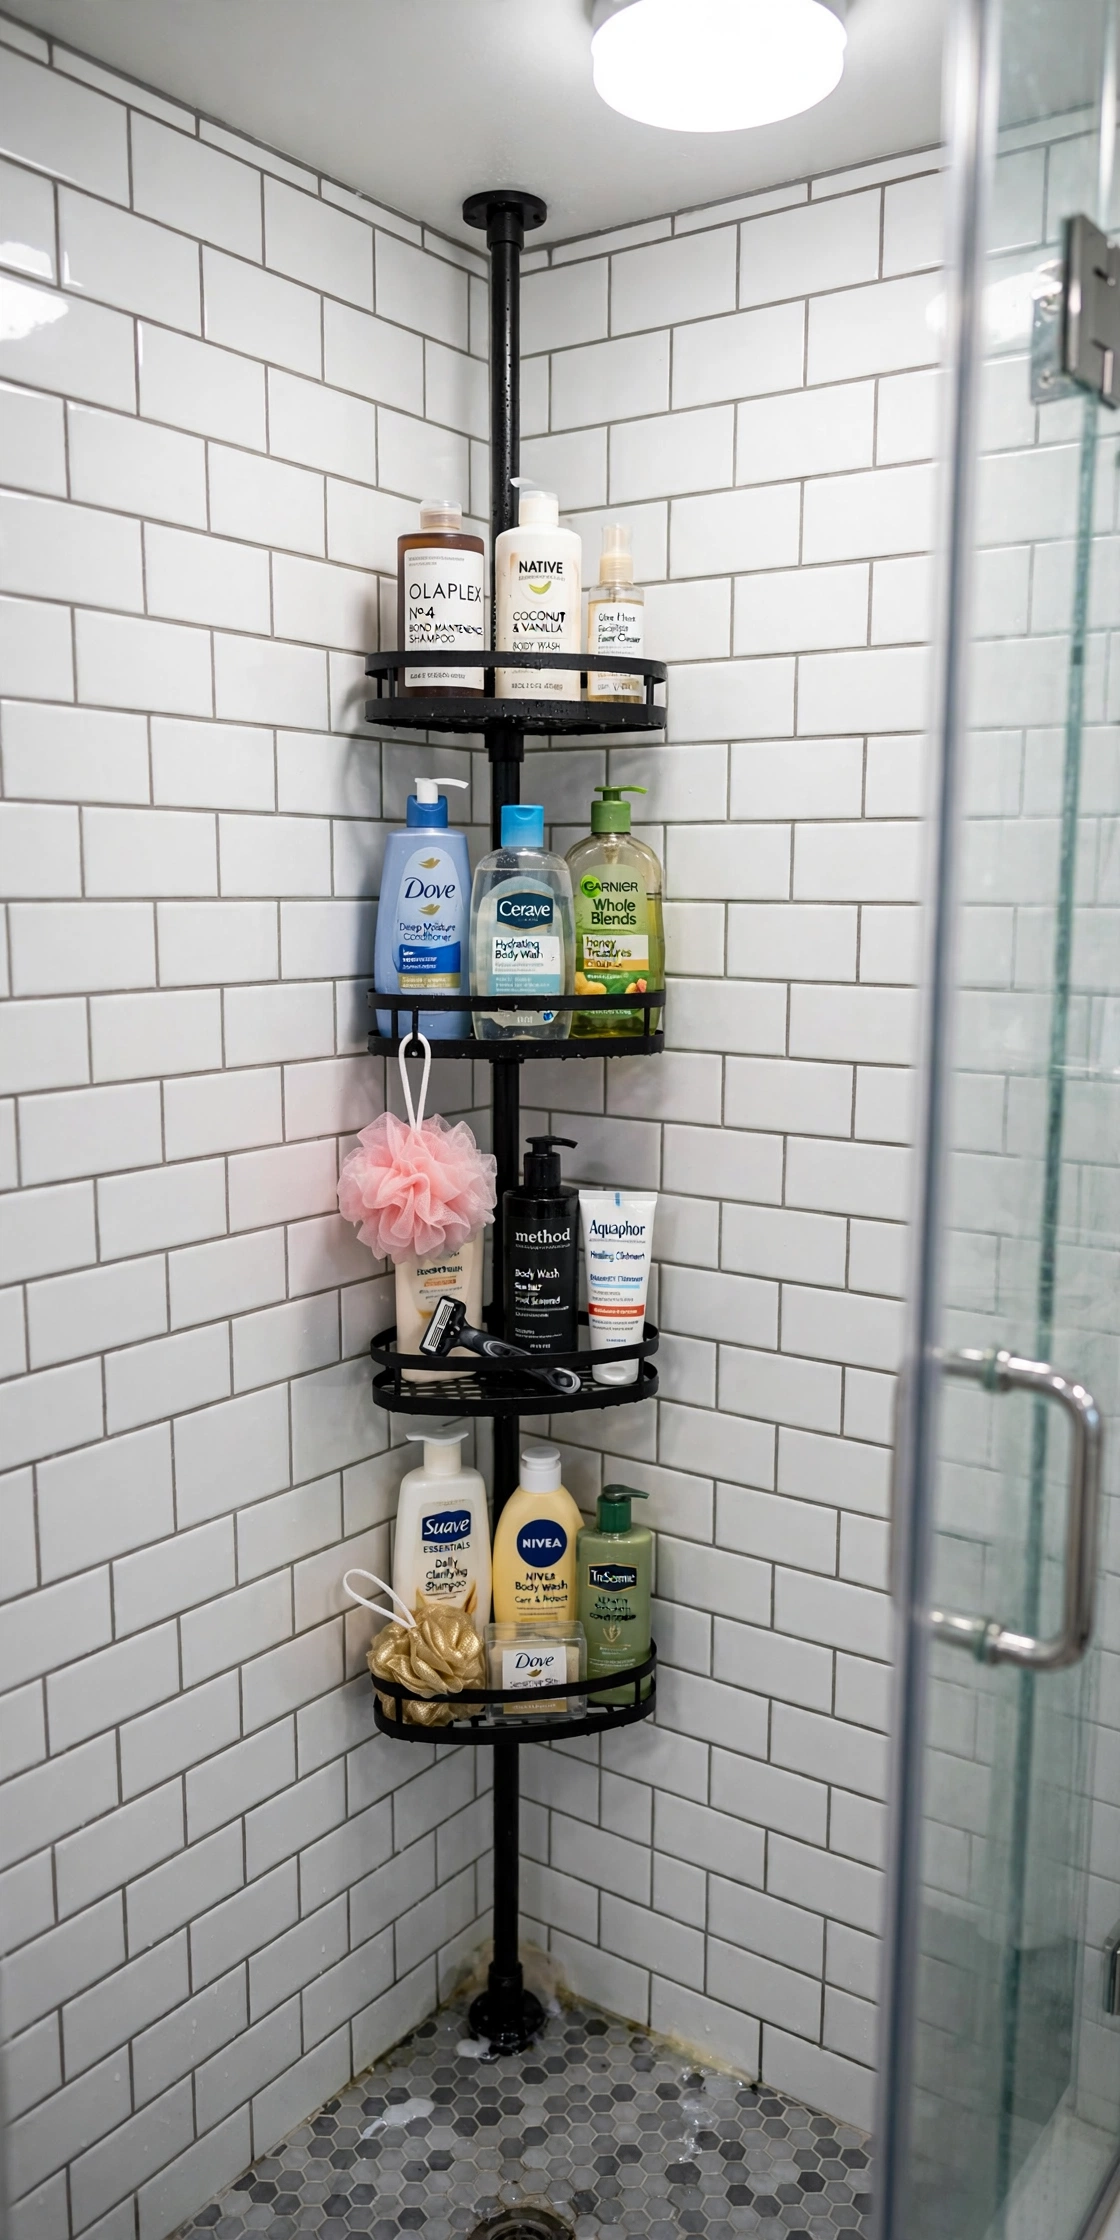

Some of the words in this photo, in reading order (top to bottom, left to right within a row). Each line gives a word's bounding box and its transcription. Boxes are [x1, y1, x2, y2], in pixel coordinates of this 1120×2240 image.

[519, 560, 563, 574] NATIVE
[409, 583, 481, 603] OLAPLEX
[513, 610, 566, 623] COCONUT
[521, 623, 563, 633] VANILLA
[409, 634, 455, 644] SHAMPOO
[512, 642, 534, 651] BODY
[537, 642, 561, 651] WASH
[404, 877, 456, 899] Dove
[583, 881, 638, 893] GARNIER
[593, 899, 636, 913] Whole
[591, 911, 637, 925] Blends
[495, 938, 540, 951] Hydrating
[495, 950, 518, 961] Body
[589, 1219, 646, 1238] Aquaphor
[515, 1228, 571, 1244] method
[515, 1268, 535, 1280] Body
[536, 1268, 560, 1279] Wash
[424, 1518, 470, 1535] Suave
[423, 1541, 471, 1553] ESSENTIALS
[522, 1538, 562, 1548] NIVEA
[515, 1581, 540, 1593] Body
[515, 1652, 555, 1669] Dove
